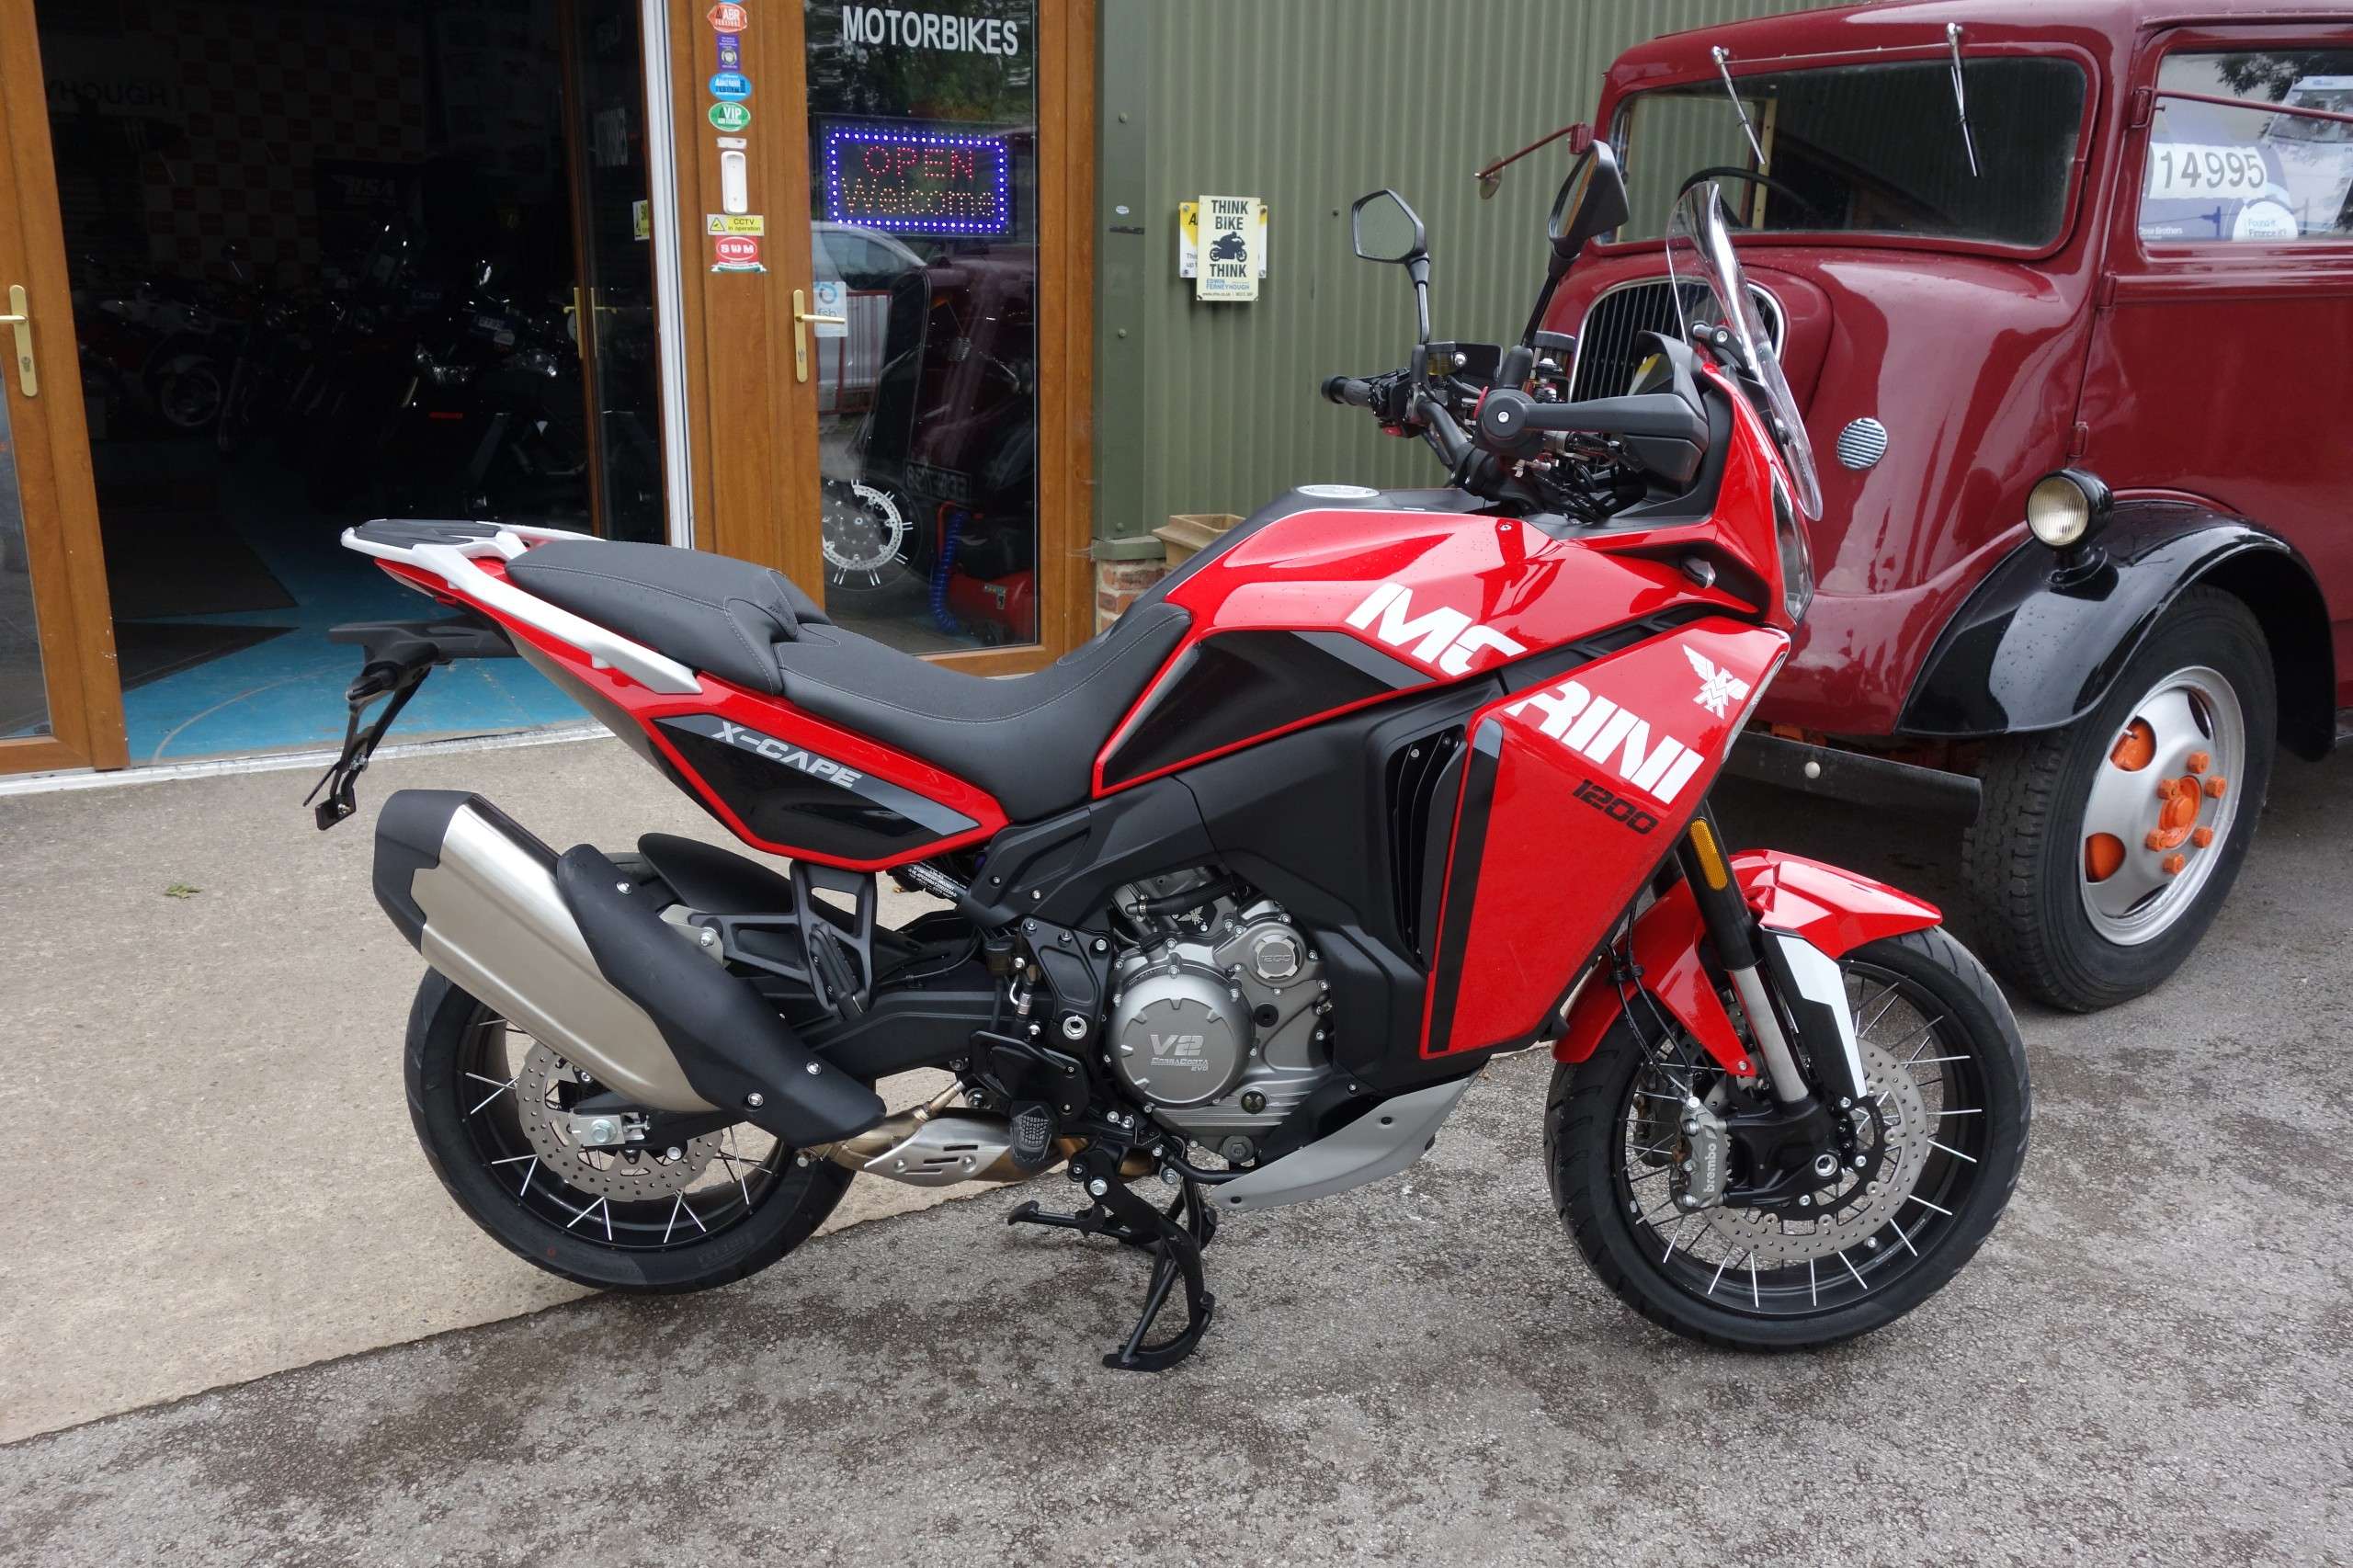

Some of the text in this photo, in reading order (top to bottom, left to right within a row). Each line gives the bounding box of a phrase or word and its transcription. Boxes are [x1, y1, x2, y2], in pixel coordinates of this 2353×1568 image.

[842, 6, 1019, 56] MOTORBIKES
[722, 107, 742, 119] VIP
[863, 145, 975, 179] OPEN
[2160, 150, 2265, 189] 14995
[841, 177, 996, 218] Welcome
[1211, 199, 1248, 214] THINK
[733, 218, 755, 226] CCTV
[1215, 216, 1244, 230] BIKE
[720, 244, 755, 254] SWM
[1209, 264, 1247, 278] THINK
[711, 721, 863, 788] X-CAPE
[1571, 778, 1658, 835] 1200
[1150, 1034, 1204, 1056] V2
[1703, 1142, 1717, 1193] brembo
